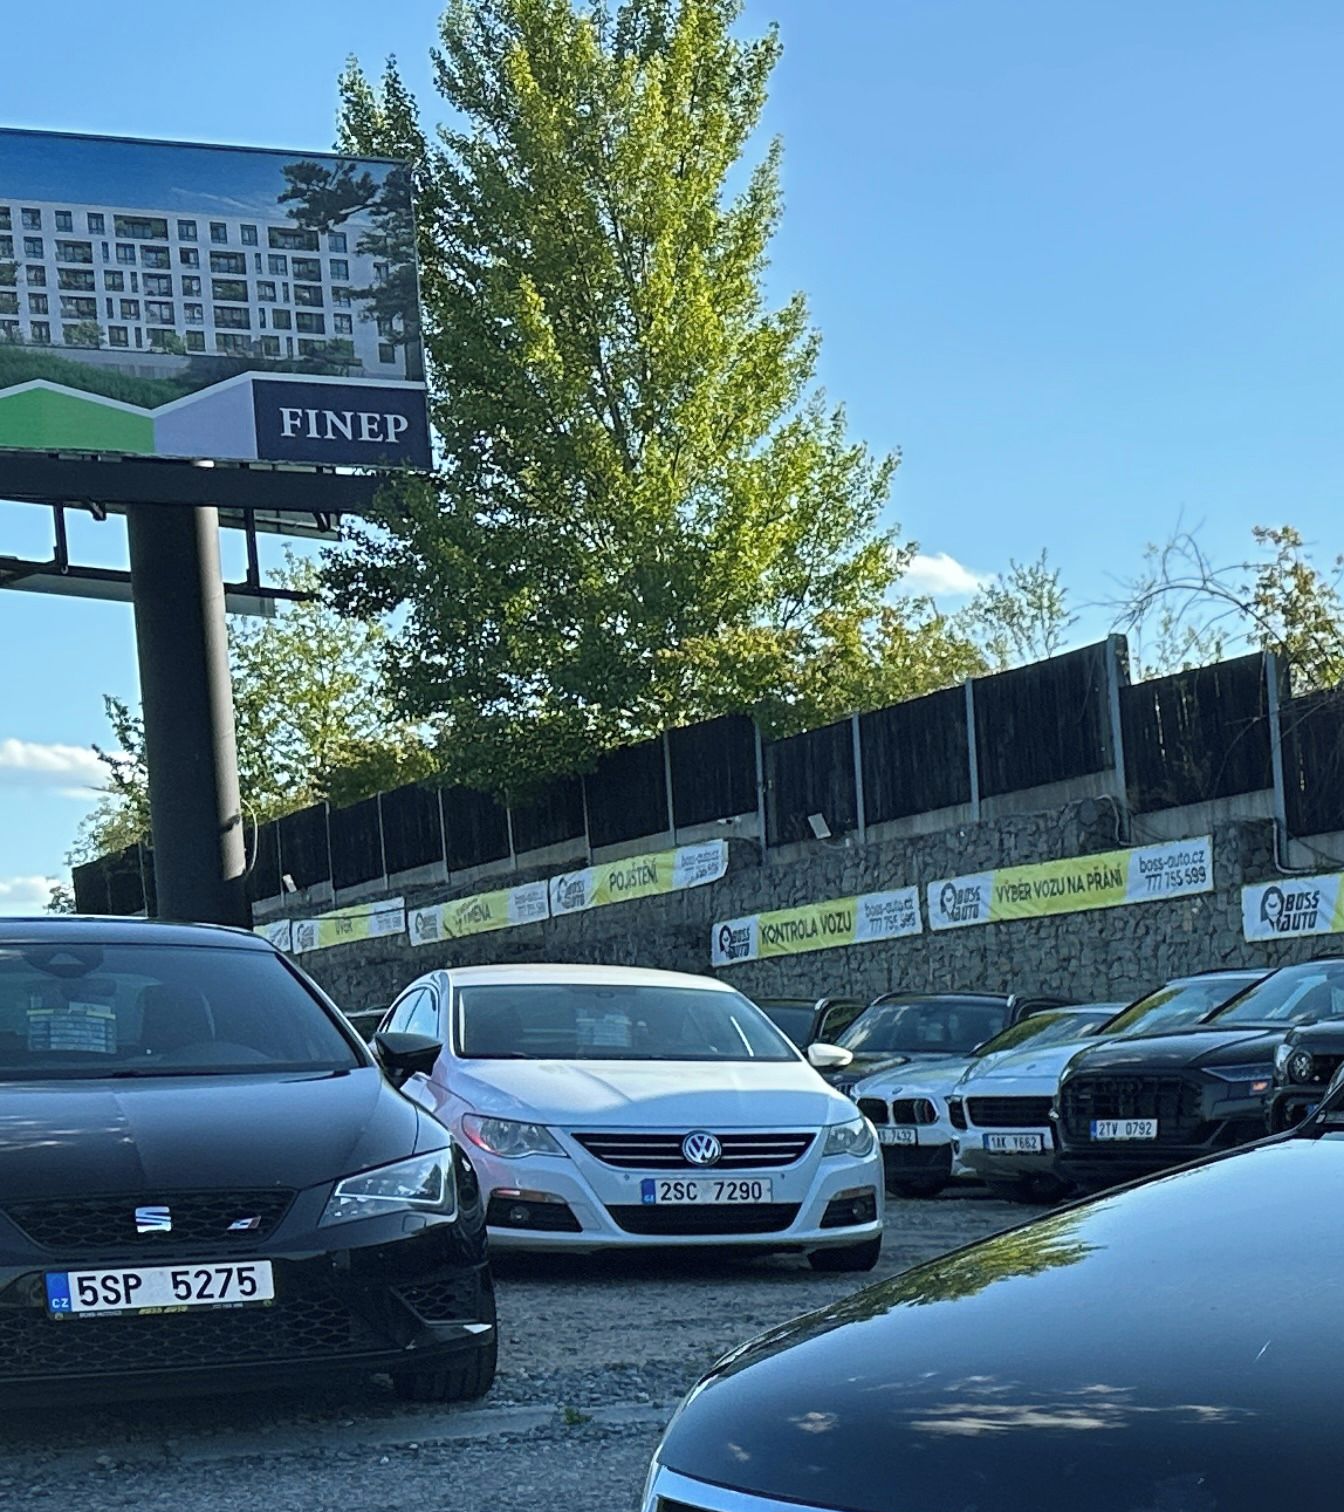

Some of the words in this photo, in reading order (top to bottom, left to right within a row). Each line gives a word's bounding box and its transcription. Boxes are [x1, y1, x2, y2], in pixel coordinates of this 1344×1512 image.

[280, 407, 409, 444] FINEP
[1139, 849, 1205, 873] boss-auto.cz
[1034, 876, 1064, 899] VOZU
[1067, 876, 1085, 894] NA
[1284, 889, 1320, 912] BOSS
[761, 918, 818, 945] KONTROLA
[820, 911, 851, 935] VOZU
[1278, 911, 1318, 932] AUTO
[1098, 1121, 1118, 1136] 2TV
[1125, 1121, 1152, 1136] 0792
[660, 1181, 698, 1201] 2SC
[713, 1181, 762, 1201] 7290
[52, 1299, 69, 1310] CZ
[77, 1273, 142, 1306] 5SP
[171, 1266, 257, 1300] 5275
